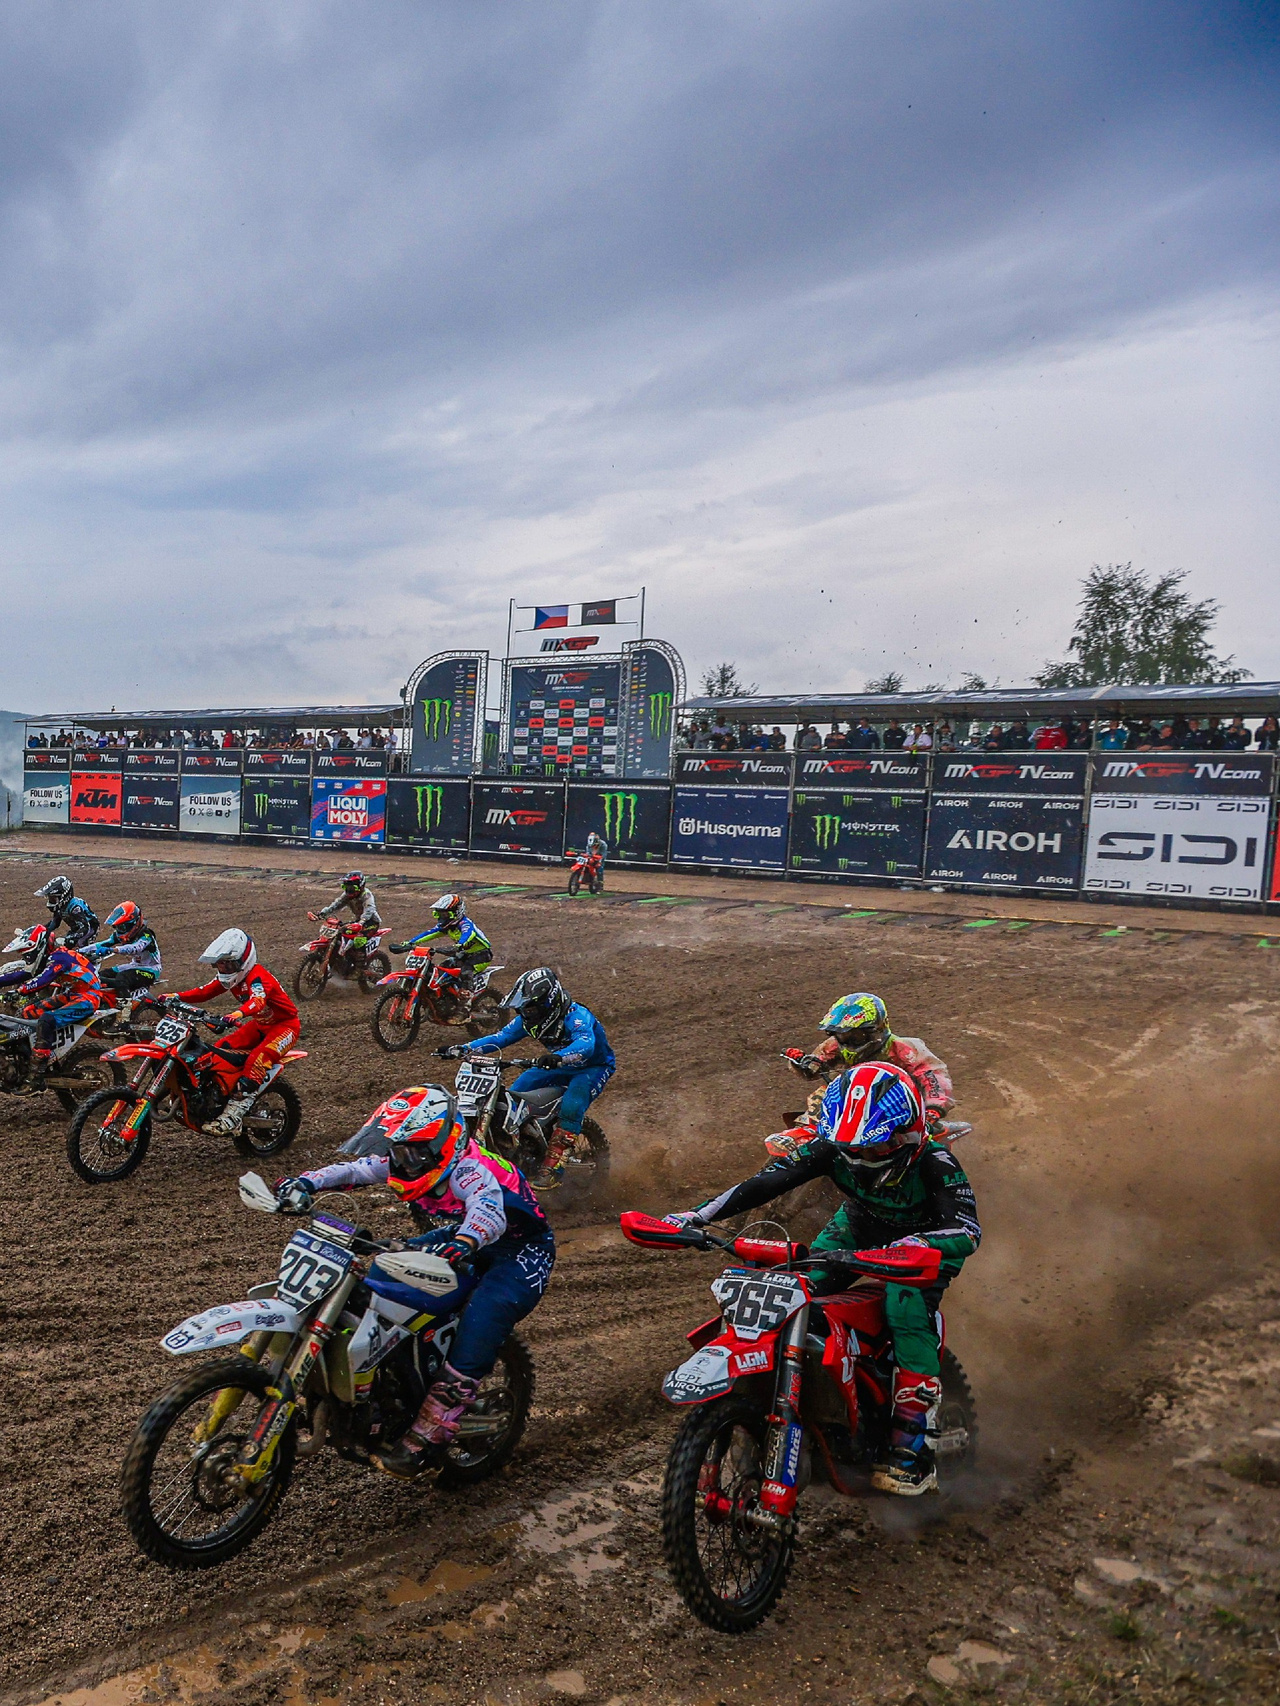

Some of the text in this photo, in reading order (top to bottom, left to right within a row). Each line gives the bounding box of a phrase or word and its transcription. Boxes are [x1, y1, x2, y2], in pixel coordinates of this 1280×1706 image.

[540, 636, 600, 652] MXGP
[545, 672, 592, 685] MXGP
[30, 789, 63, 799] FOLLOW US
[74, 788, 118, 809] KTM
[189, 795, 232, 807] FOLLOW US
[329, 796, 366, 811] LIQUI
[935, 799, 1080, 810] AIROH AIROH AIROH
[1093, 800, 1266, 813] SIDI SIDI SIDI
[329, 811, 366, 825] MOLY
[485, 808, 549, 825] MXGP
[696, 820, 782, 838] Husqvarna
[841, 822, 900, 832] MONSTER
[946, 829, 1062, 854] AIROH
[1096, 831, 1258, 867] SIDI
[930, 869, 1073, 885] AIROH AIROH AIROH
[1086, 878, 1257, 898] SIDI SIDI SIDI
[155, 1020, 186, 1043] 525
[457, 1075, 495, 1096] 208
[860, 1124, 891, 1143] AIROH
[743, 1238, 788, 1248] GASGAS
[277, 1248, 340, 1304] 203
[762, 1272, 798, 1286] LGM
[720, 1281, 794, 1330] 265
[734, 1351, 768, 1369] LGM
[665, 1380, 706, 1395] AIROH
[676, 1373, 704, 1386] CPL
[761, 1482, 786, 1497] LGM
